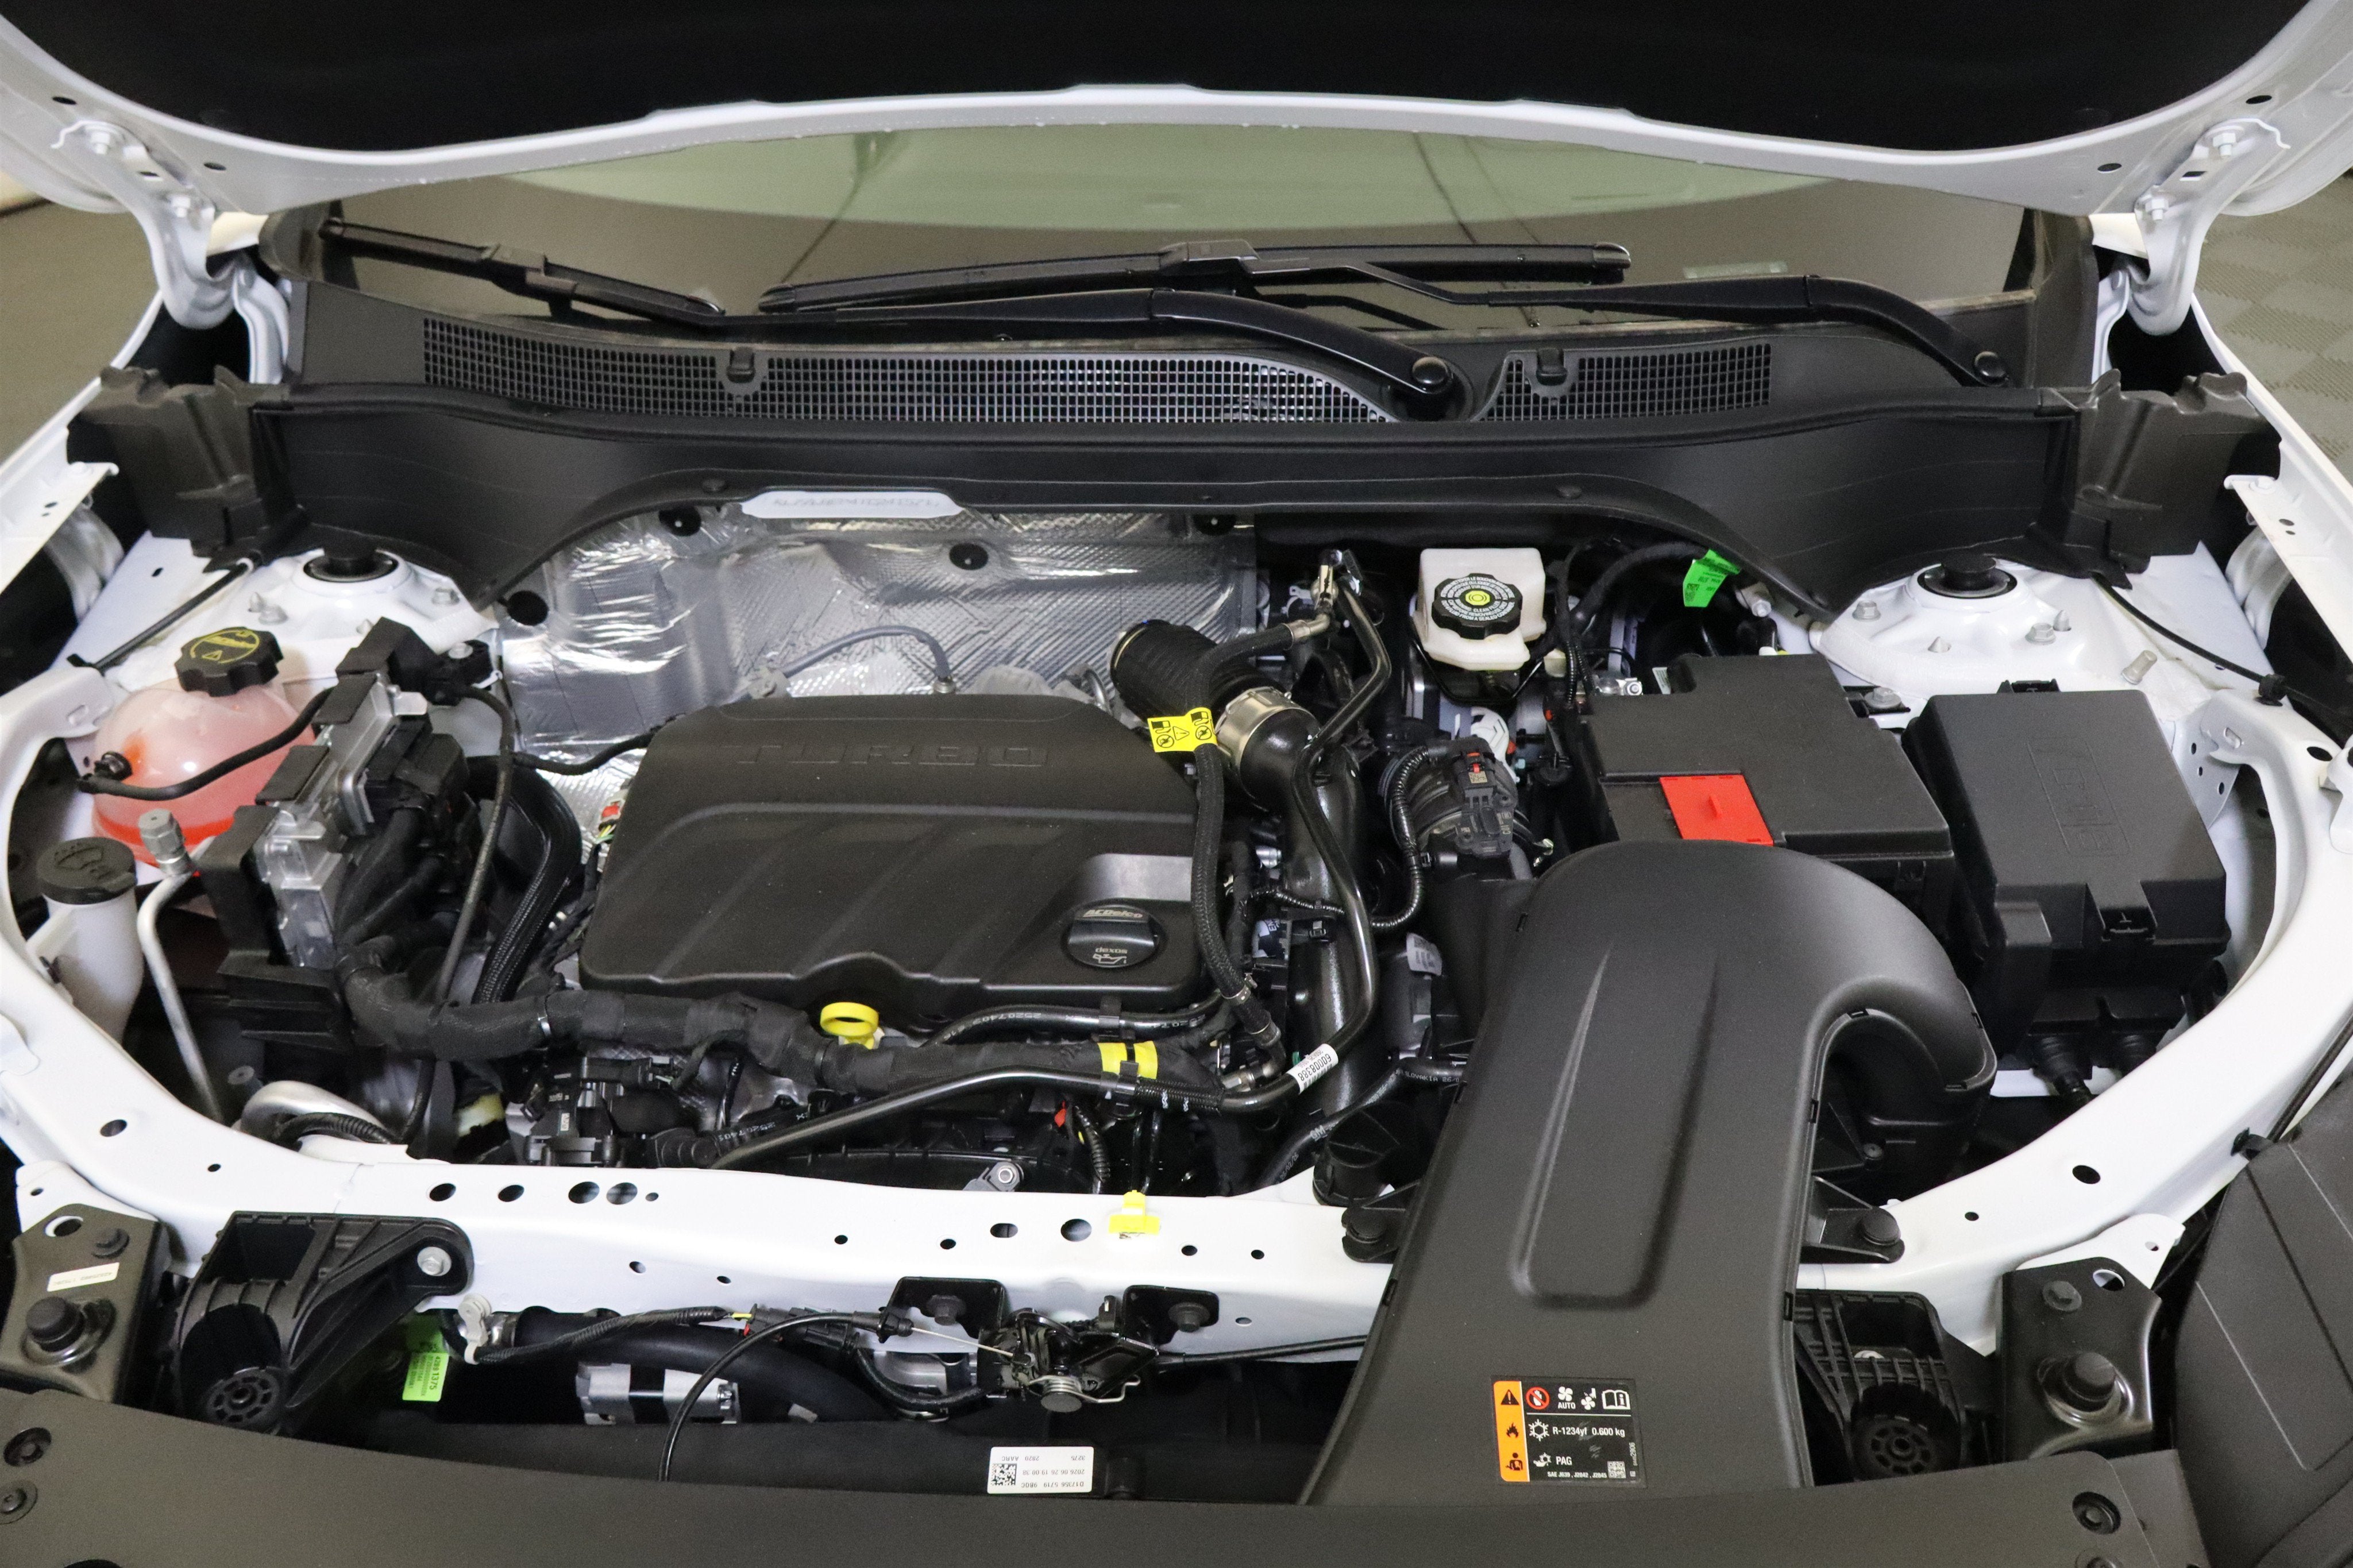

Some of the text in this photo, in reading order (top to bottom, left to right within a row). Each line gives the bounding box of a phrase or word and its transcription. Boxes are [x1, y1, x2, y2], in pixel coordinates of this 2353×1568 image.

[720, 744, 1050, 767] TURBO
[1082, 909, 1143, 918] ACDelco
[1095, 946, 1128, 954] dexos
[1298, 1053, 1332, 1081] 60008388
[1552, 1427, 1626, 1438] R-1234yf 0.600 kg
[1556, 1456, 1572, 1466] PAG
